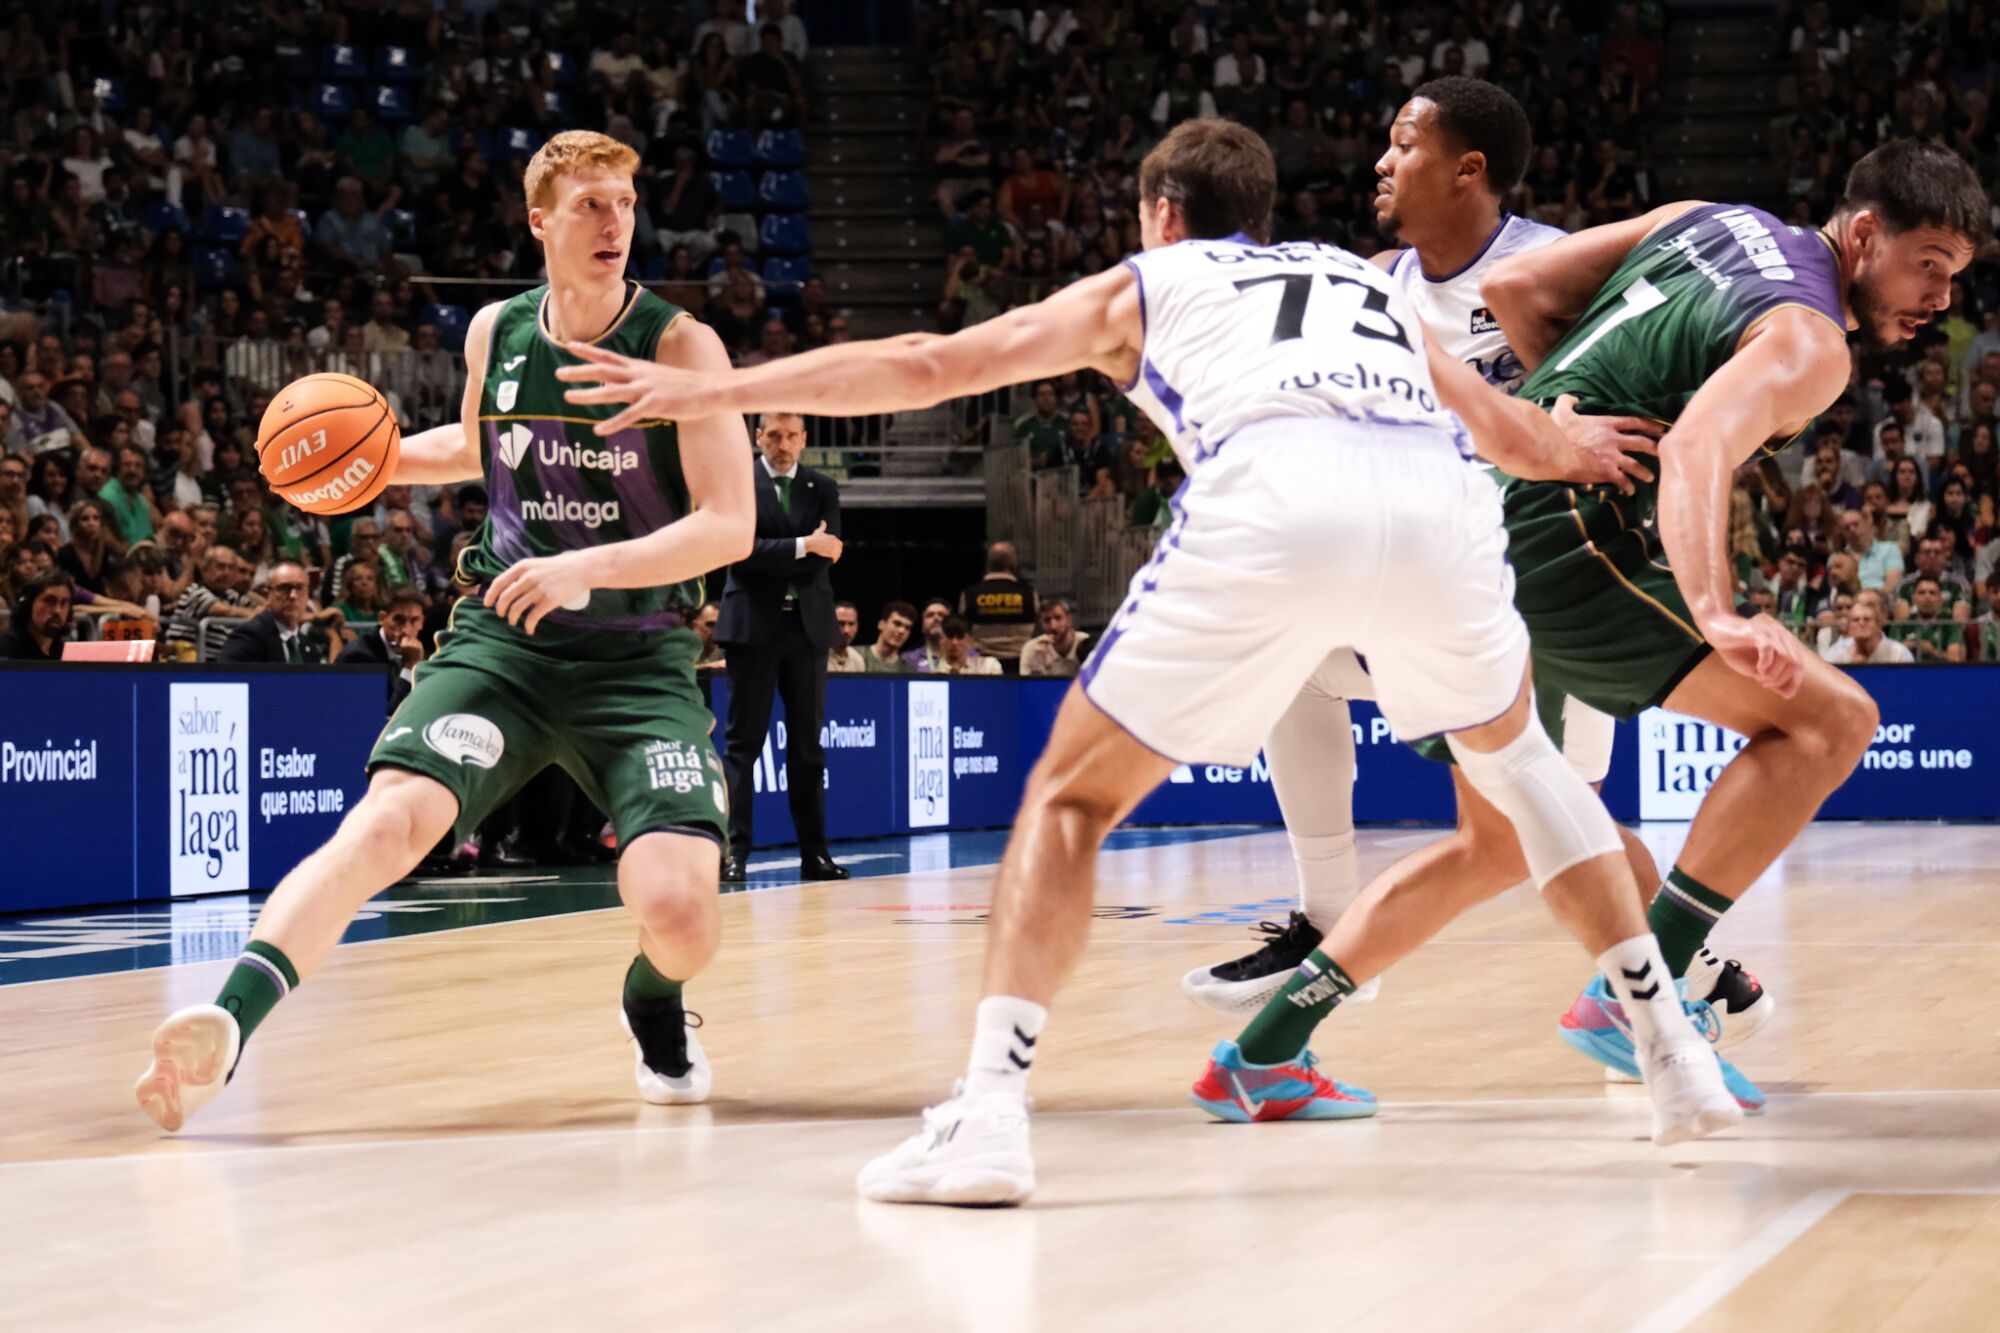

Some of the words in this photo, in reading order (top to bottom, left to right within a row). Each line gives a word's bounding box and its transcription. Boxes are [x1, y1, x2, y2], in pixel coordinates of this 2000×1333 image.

[1231, 273, 1416, 355] 73
[280, 429, 327, 469] EVO
[538, 439, 640, 477] Unicaja
[288, 457, 376, 505] Wilson
[976, 593, 1023, 607] COFER
[178, 696, 222, 735] sabor
[829, 719, 876, 748] Provincial
[644, 740, 682, 755] sabor
[962, 726, 984, 748] sabor
[2, 738, 97, 783] Provincial
[178, 749, 187, 774] a
[189, 722, 240, 796] má
[260, 748, 275, 779] El
[276, 747, 317, 778] sabor
[656, 744, 703, 770] má
[953, 757, 969, 780] que
[983, 755, 998, 773] une
[1863, 750, 1914, 769] nos
[1920, 749, 1972, 769] une
[649, 767, 706, 793] laga
[914, 754, 944, 816] laga
[260, 790, 288, 824] que
[290, 789, 316, 814] nos
[317, 788, 344, 813] une
[179, 788, 240, 879] laga
